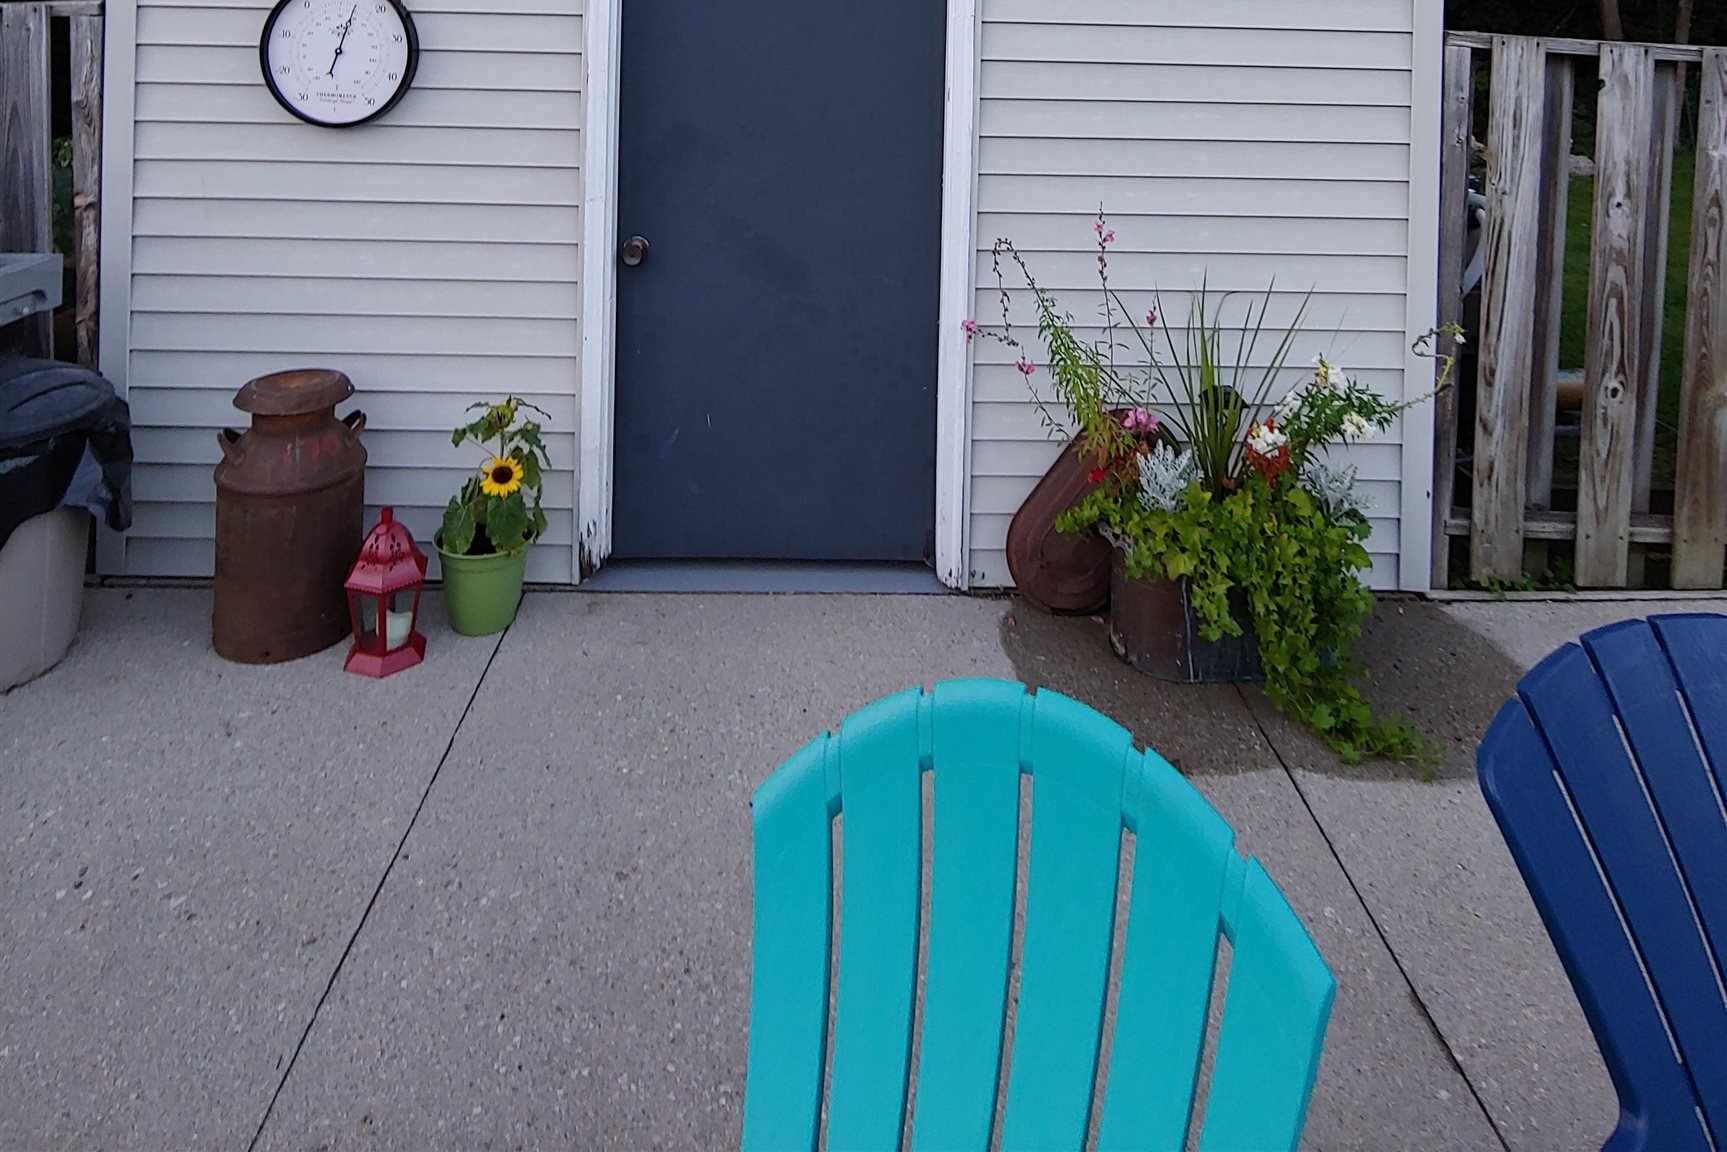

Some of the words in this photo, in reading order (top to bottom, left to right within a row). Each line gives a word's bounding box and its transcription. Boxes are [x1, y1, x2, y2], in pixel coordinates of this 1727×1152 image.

[304, 1, 311, 9] 0
[375, 5, 387, 14] 20
[392, 35, 403, 44] 30
[387, 73, 398, 81] 40
